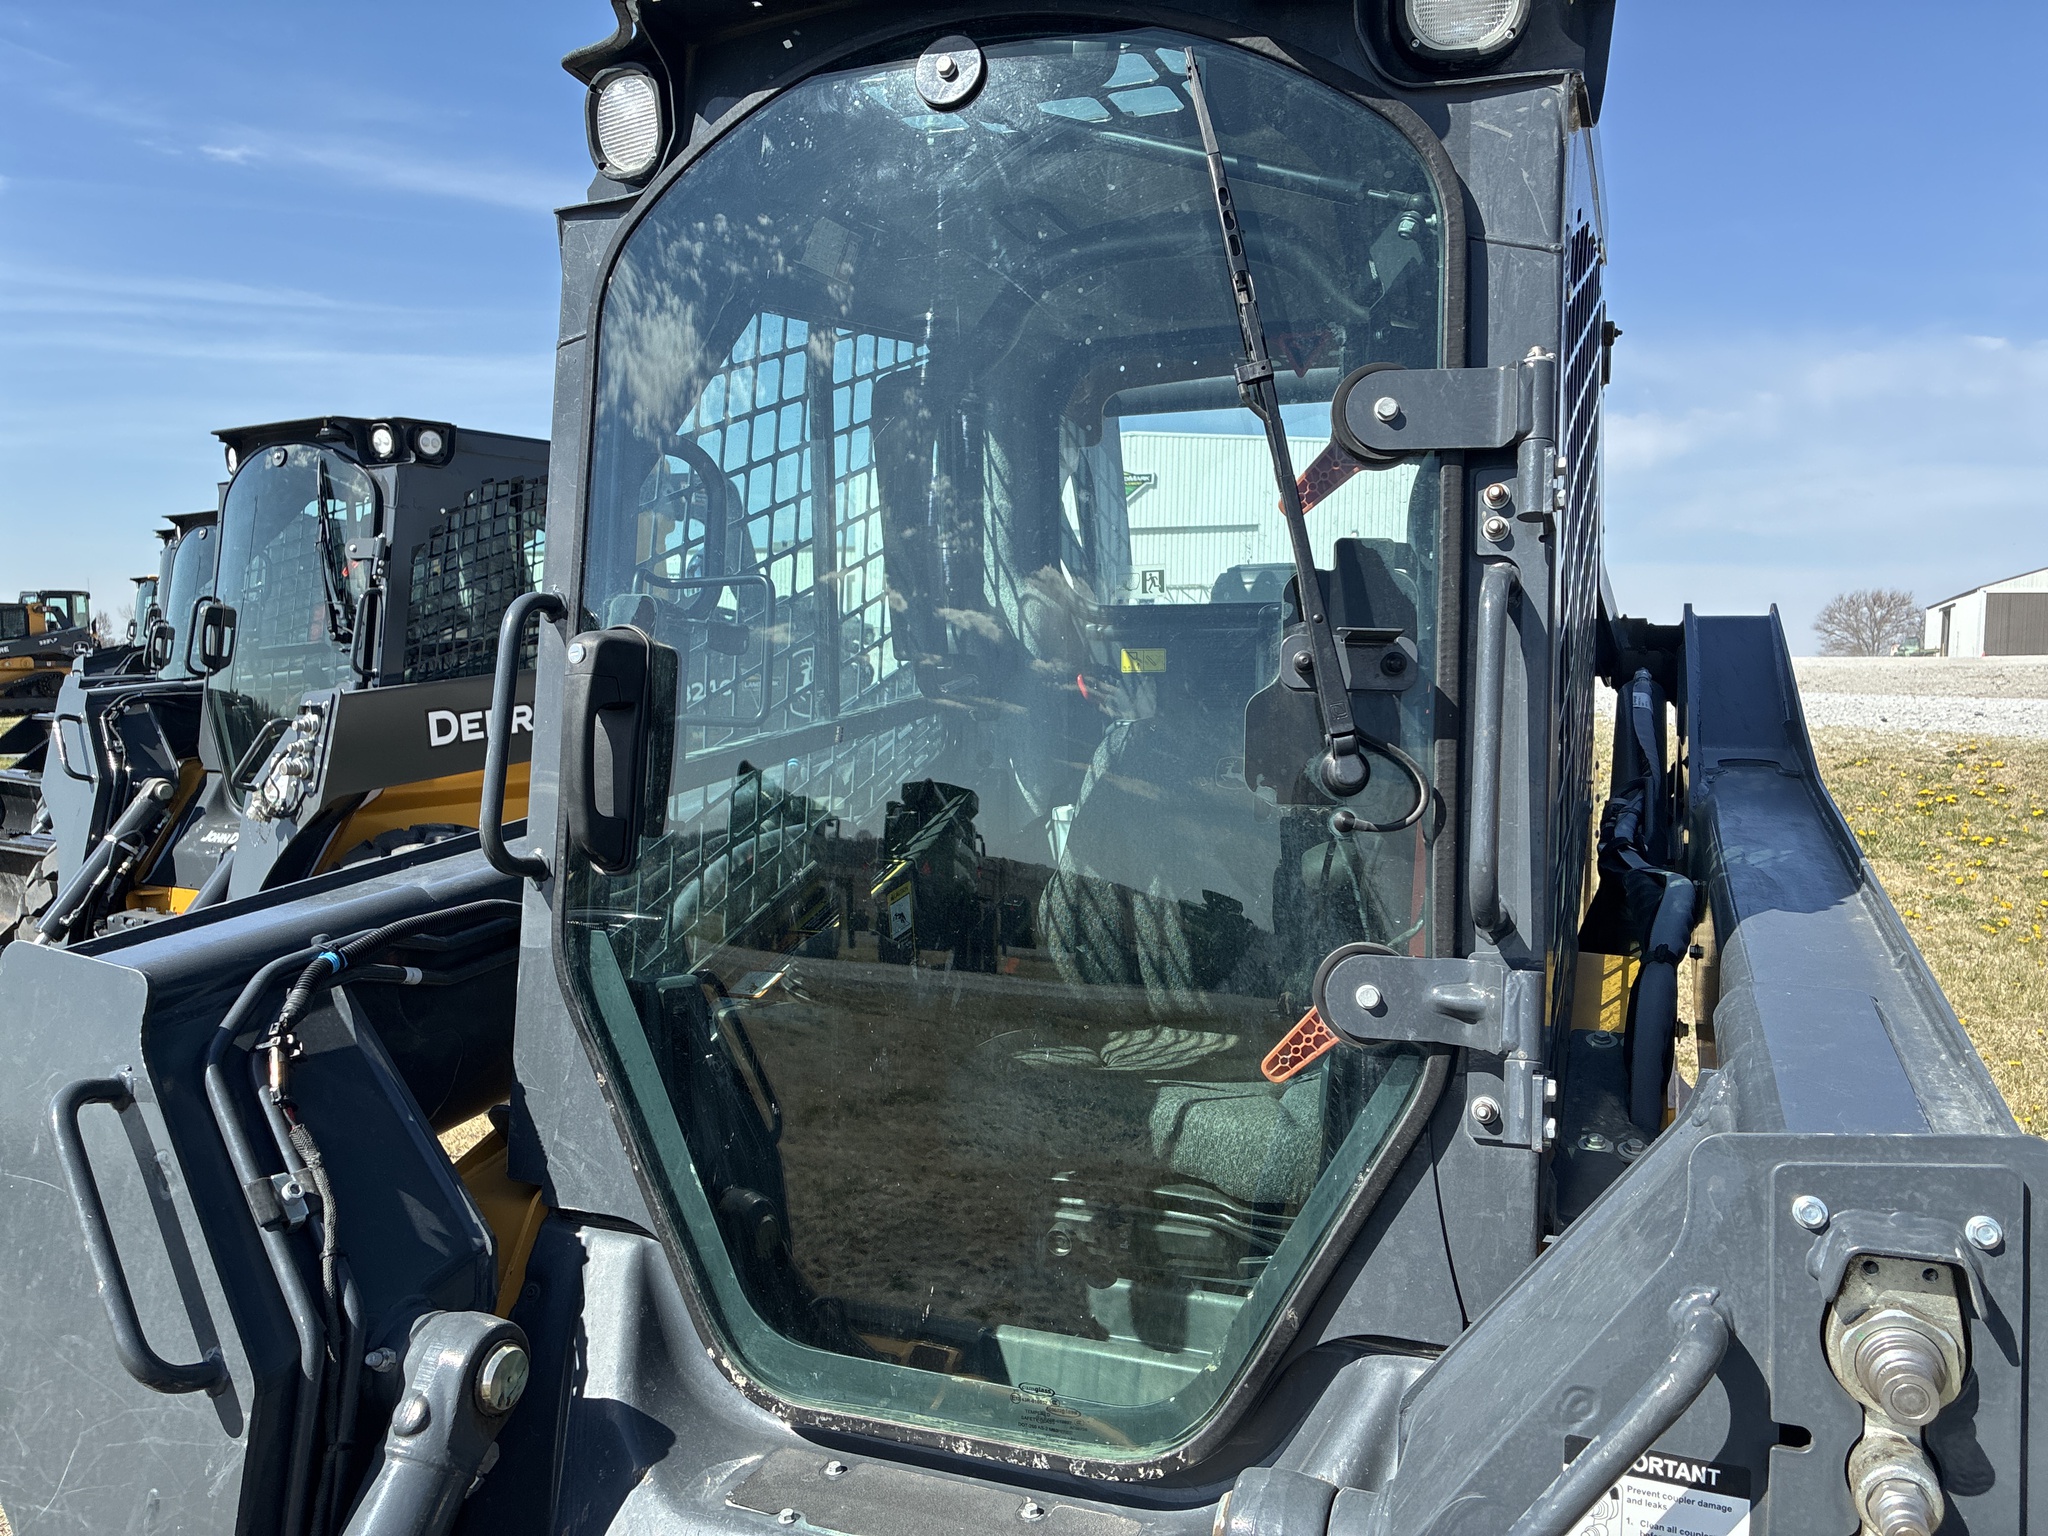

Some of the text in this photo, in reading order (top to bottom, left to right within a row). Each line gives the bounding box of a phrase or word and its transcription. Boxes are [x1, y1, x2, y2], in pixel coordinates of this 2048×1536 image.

[428, 704, 534, 747] DER
[1627, 1485, 1732, 1513] Prevent coupler damage
[1627, 1497, 1642, 1505] and
[1626, 1517, 1633, 1526] 1.
[1667, 1525, 1677, 1533] all
